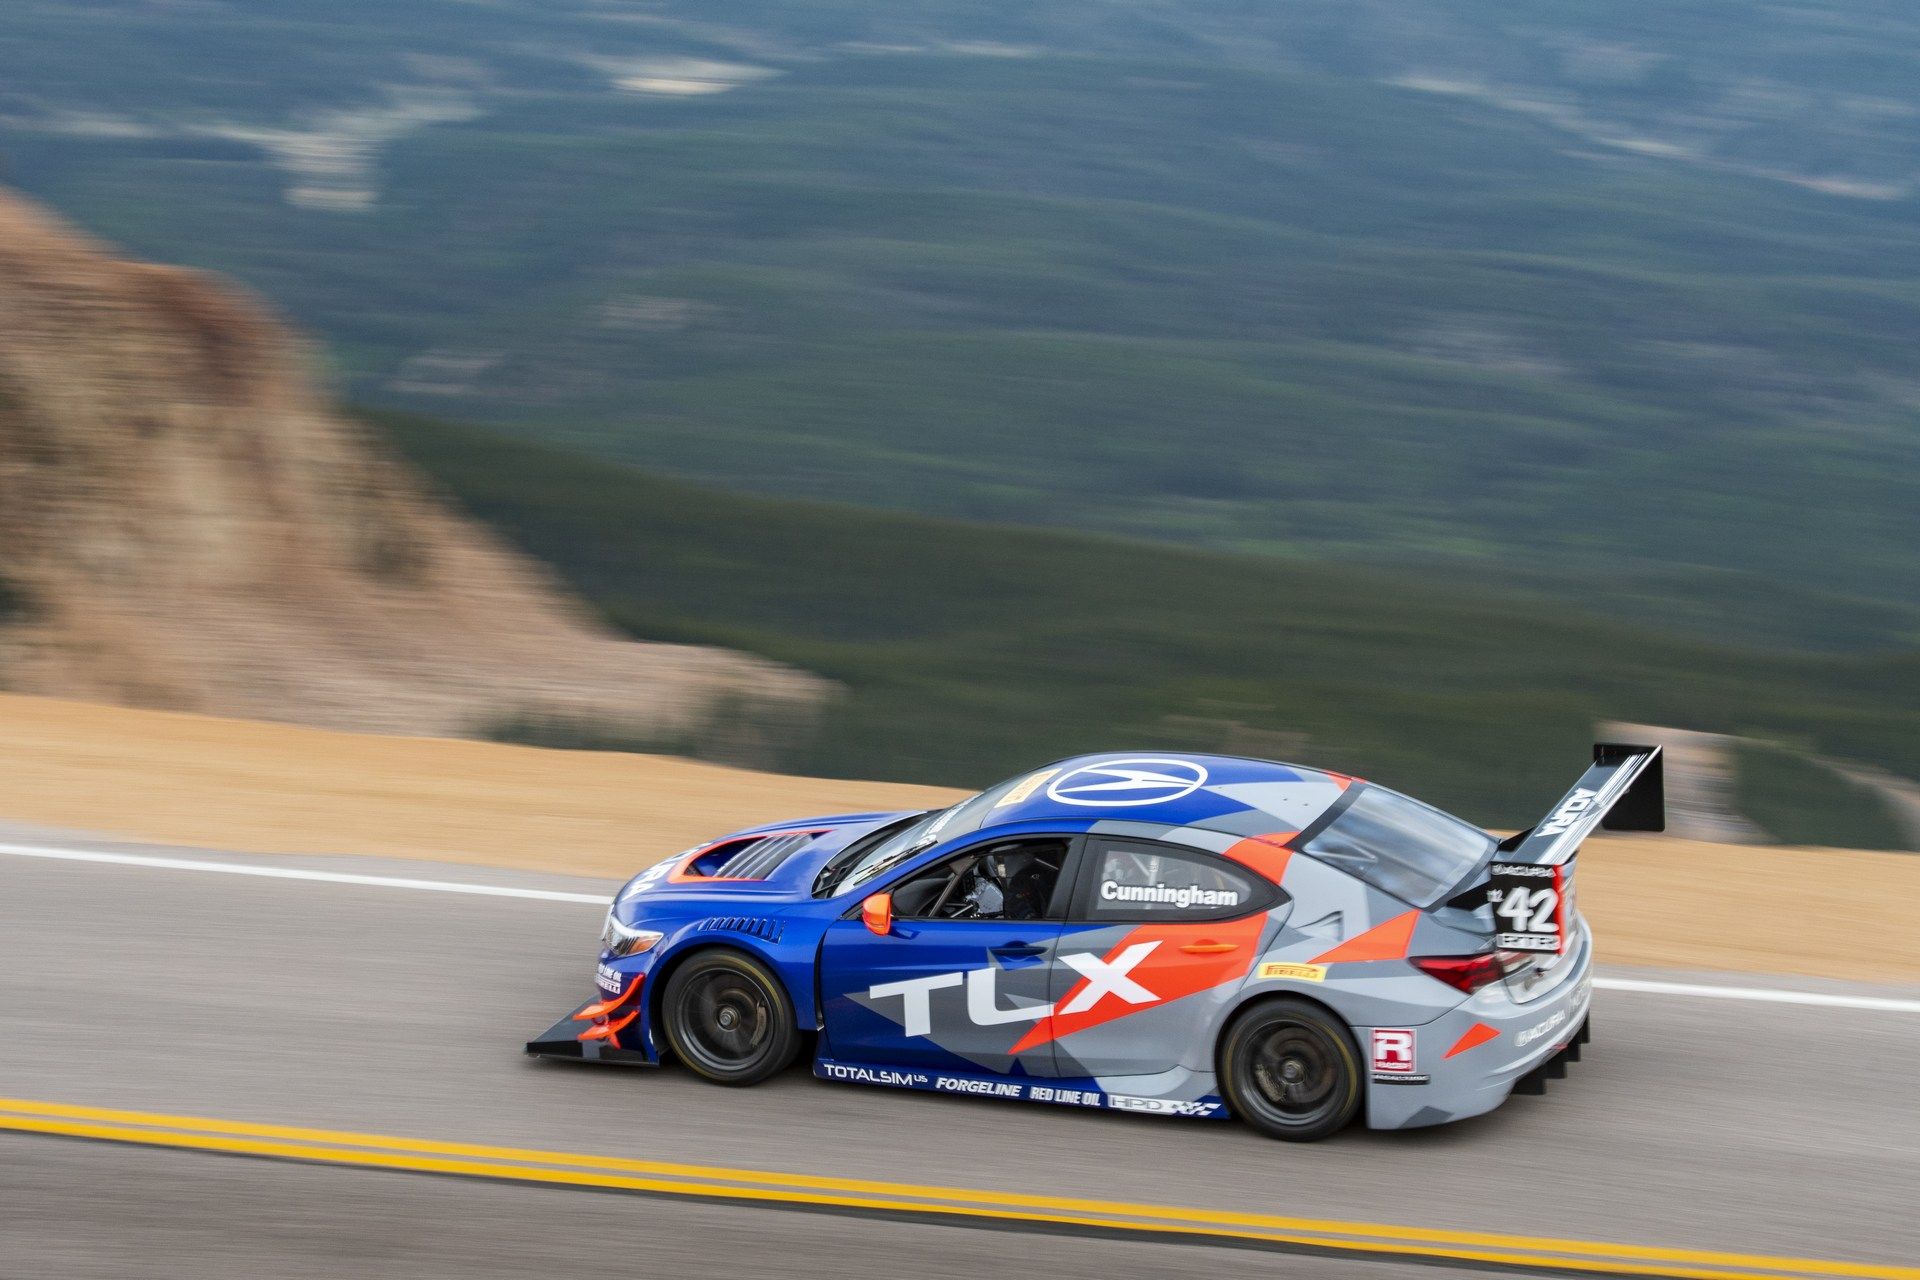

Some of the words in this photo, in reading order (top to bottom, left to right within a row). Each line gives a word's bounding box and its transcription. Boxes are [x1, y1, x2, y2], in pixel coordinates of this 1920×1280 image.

[1100, 880, 1239, 908] Cunningham
[1497, 886, 1561, 932] 42
[869, 940, 1163, 1037] TLX
[1374, 1032, 1412, 1061] R
[824, 1063, 913, 1086] TOTALSIM
[914, 1074, 928, 1083] US
[935, 1077, 1021, 1097] FORGELINE
[1029, 1086, 1054, 1102] RED
[1055, 1089, 1080, 1105] LINE
[1081, 1092, 1101, 1106] OIL
[1111, 1097, 1162, 1110] HPD
